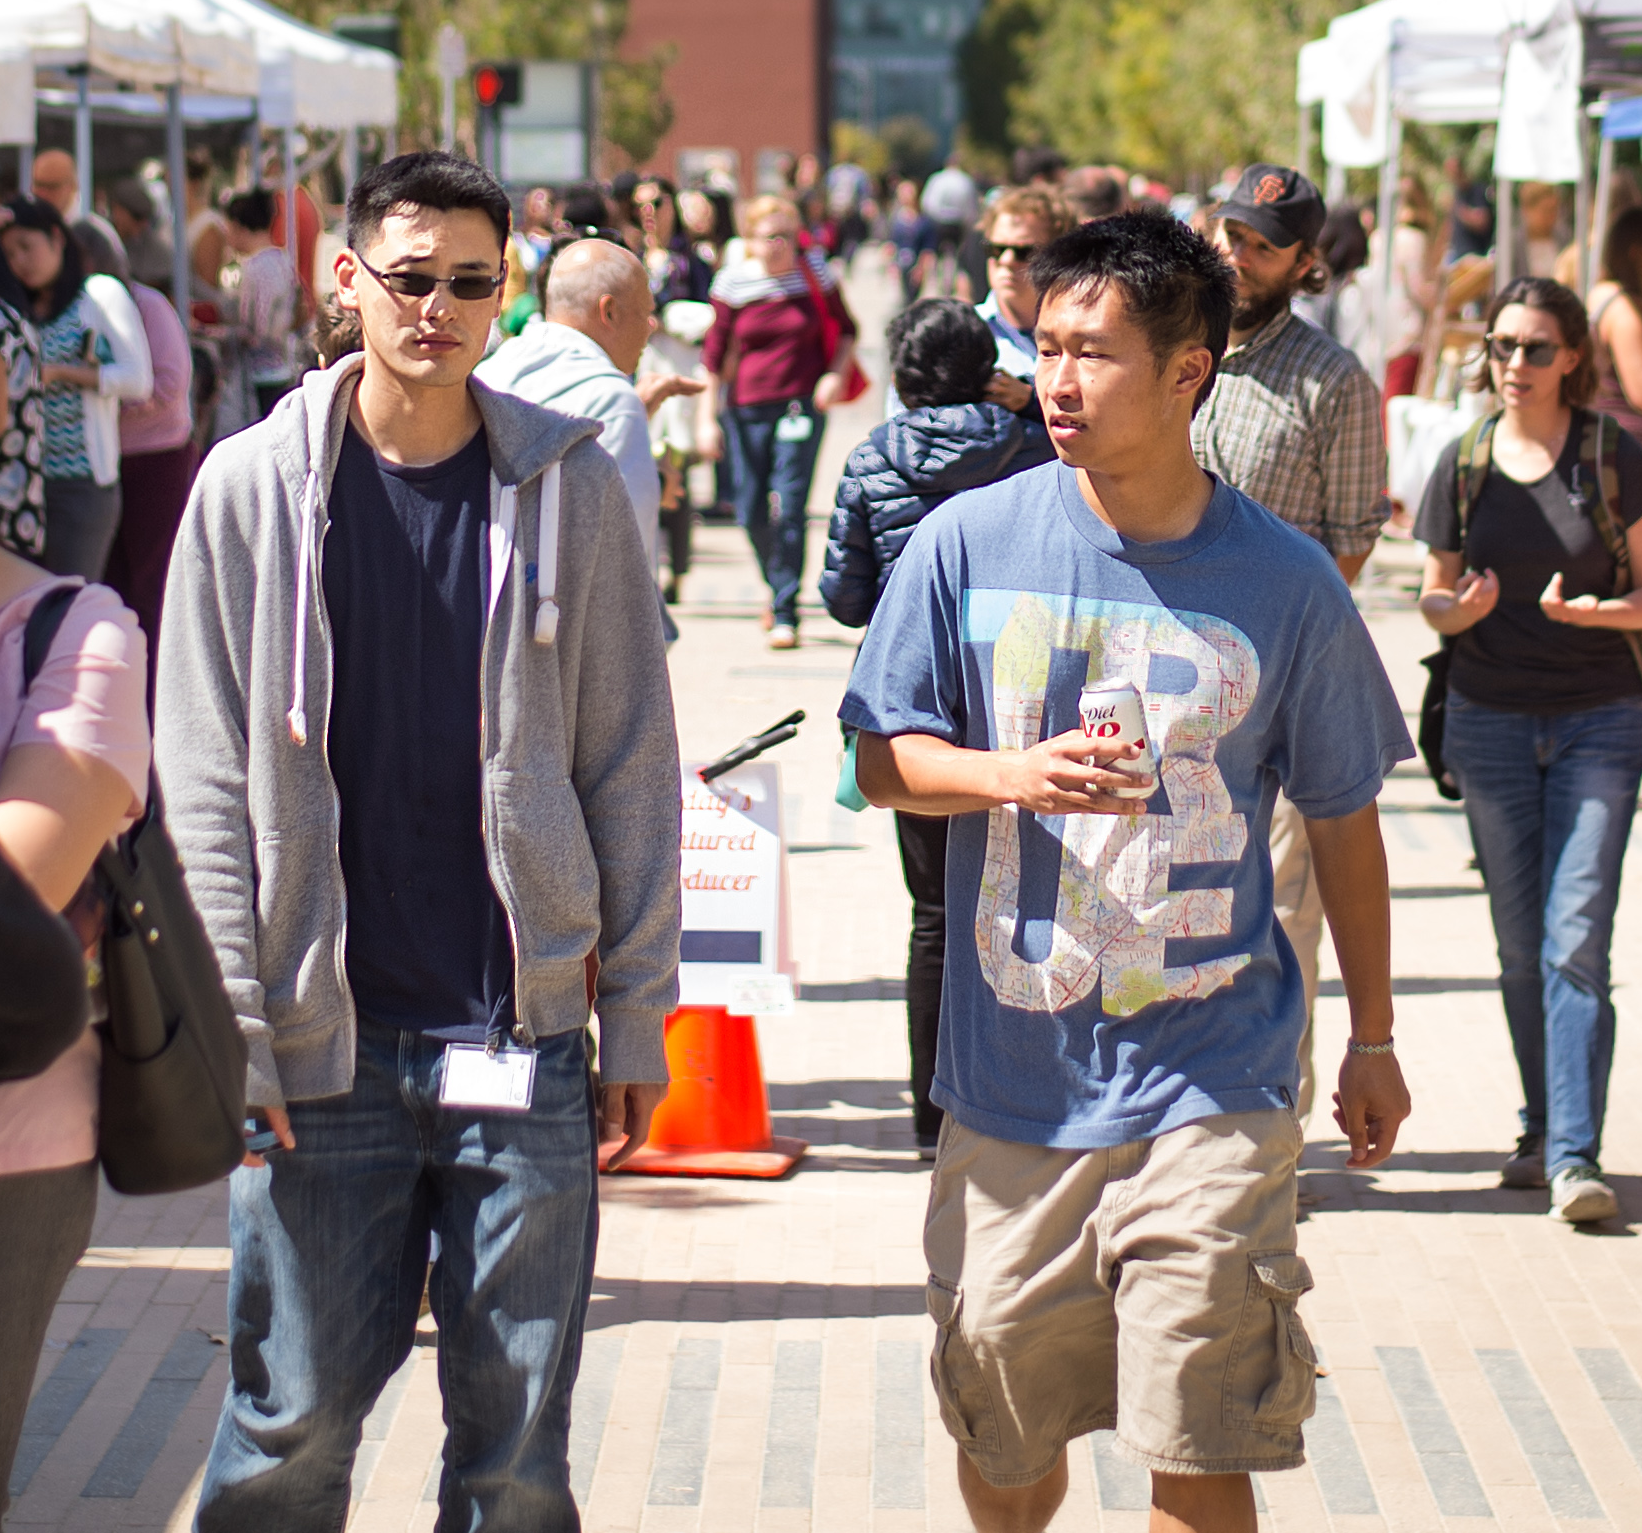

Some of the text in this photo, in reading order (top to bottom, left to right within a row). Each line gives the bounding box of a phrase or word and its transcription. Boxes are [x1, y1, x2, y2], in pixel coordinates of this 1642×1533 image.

[1085, 704, 1117, 721] Diet
[682, 788, 753, 819] day's
[681, 830, 757, 851] tured
[681, 868, 759, 891] ducer
